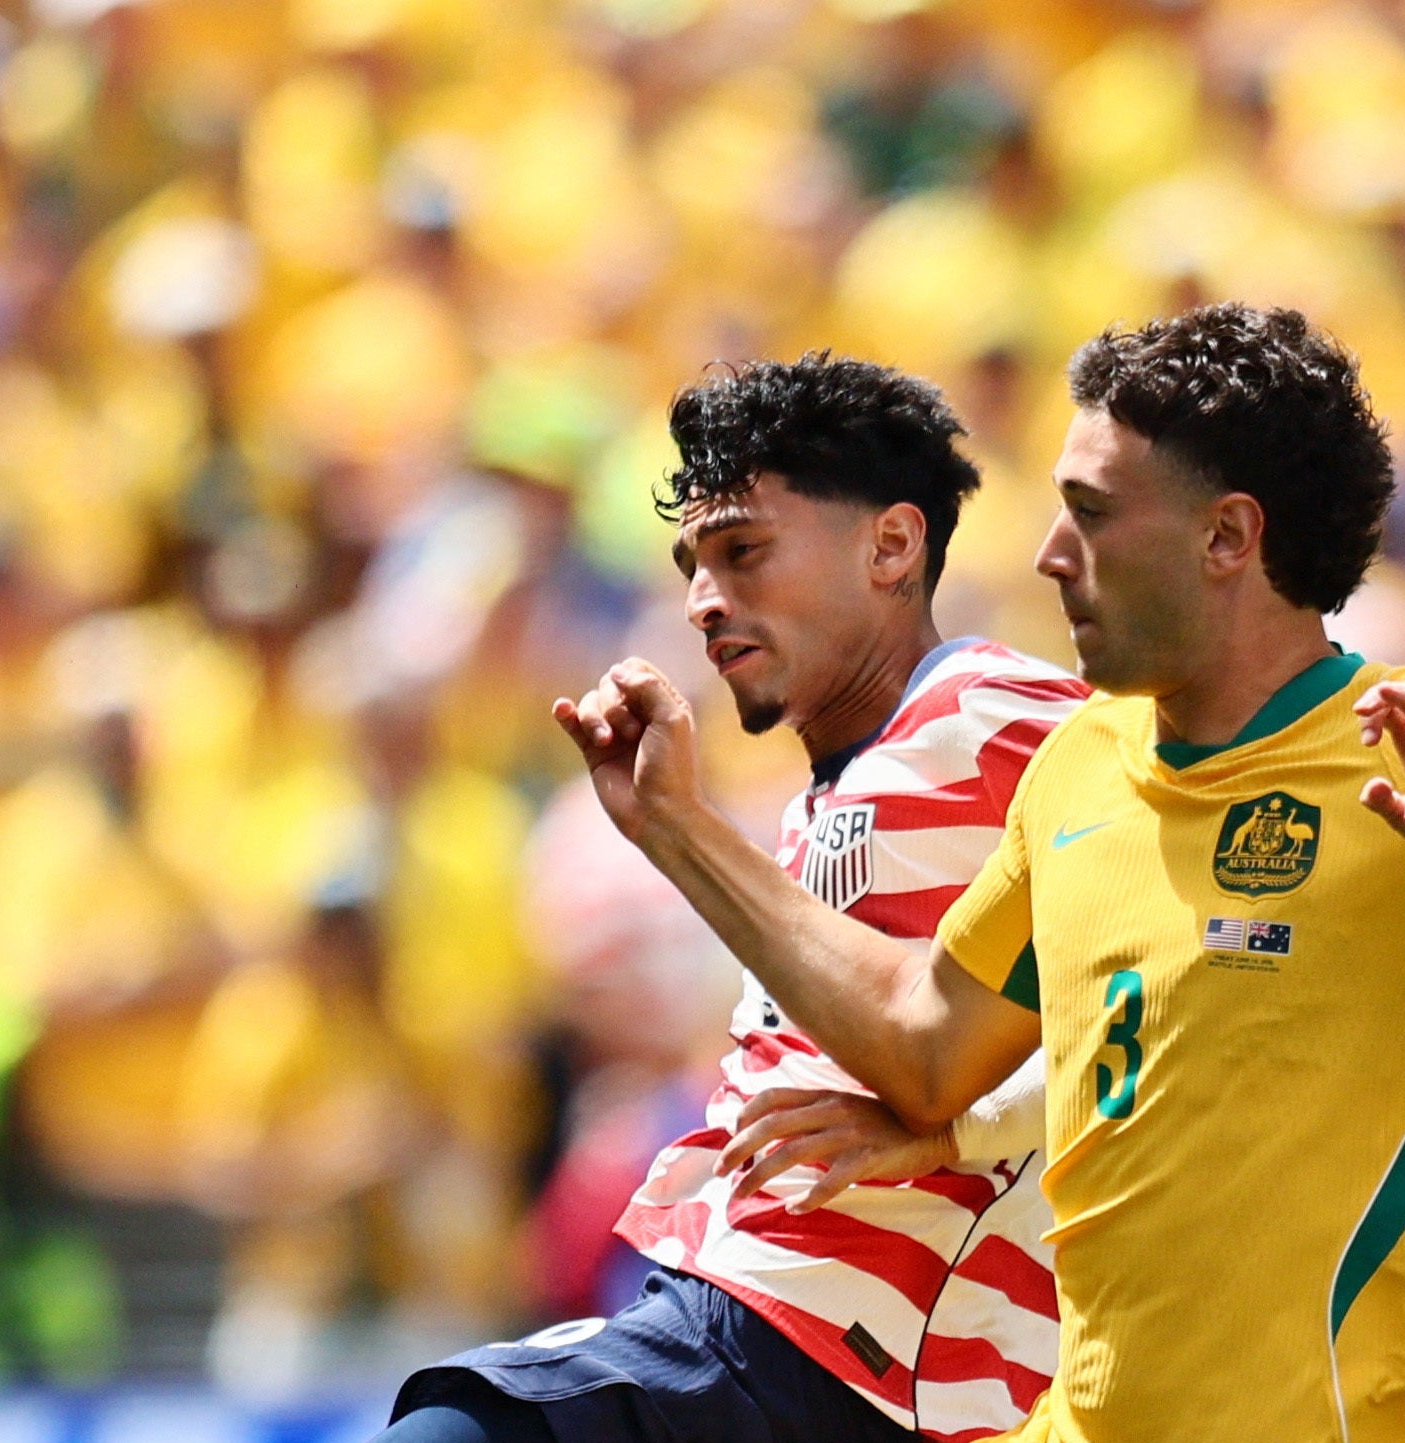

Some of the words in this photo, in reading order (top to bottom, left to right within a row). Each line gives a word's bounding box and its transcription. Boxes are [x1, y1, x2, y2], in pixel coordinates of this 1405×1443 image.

[815, 811, 868, 851] USA
[1226, 858, 1297, 870] AUSTRALIA
[1096, 969, 1143, 1120] 3
